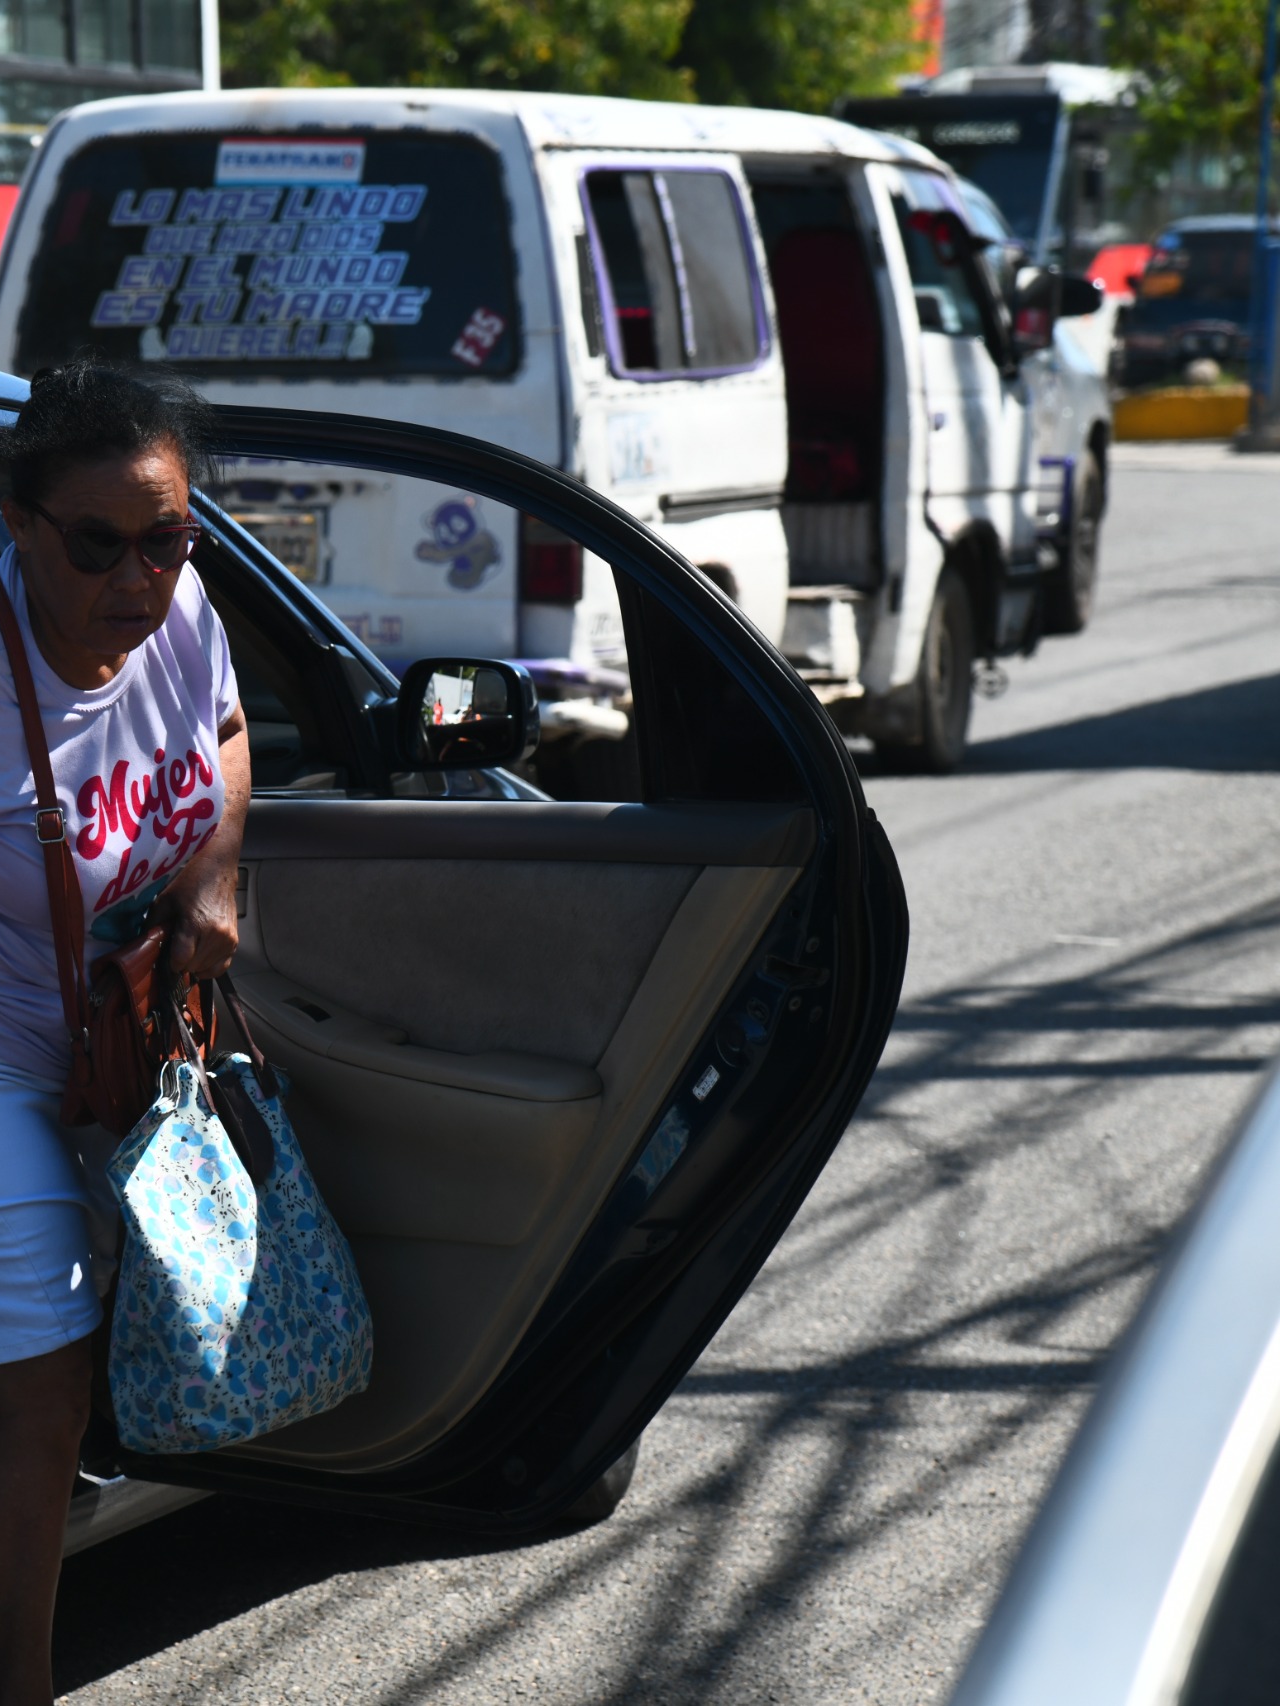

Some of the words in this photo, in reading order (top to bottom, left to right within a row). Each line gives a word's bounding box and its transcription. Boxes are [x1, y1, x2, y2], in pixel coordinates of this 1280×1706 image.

[109, 189, 176, 226] LO
[174, 187, 283, 224] MAS
[282, 185, 427, 222] LINDO
[143, 223, 216, 255] QUE
[214, 222, 297, 254] HIZO
[296, 221, 384, 253] DIOS
[116, 255, 185, 290] EN
[184, 254, 241, 289] EL
[247, 252, 409, 288] MUNDO
[91, 291, 168, 327] ES
[174, 289, 243, 324] TU
[243, 287, 428, 324] MADRE
[76, 748, 214, 861] Mujer
[93, 847, 151, 912] de
